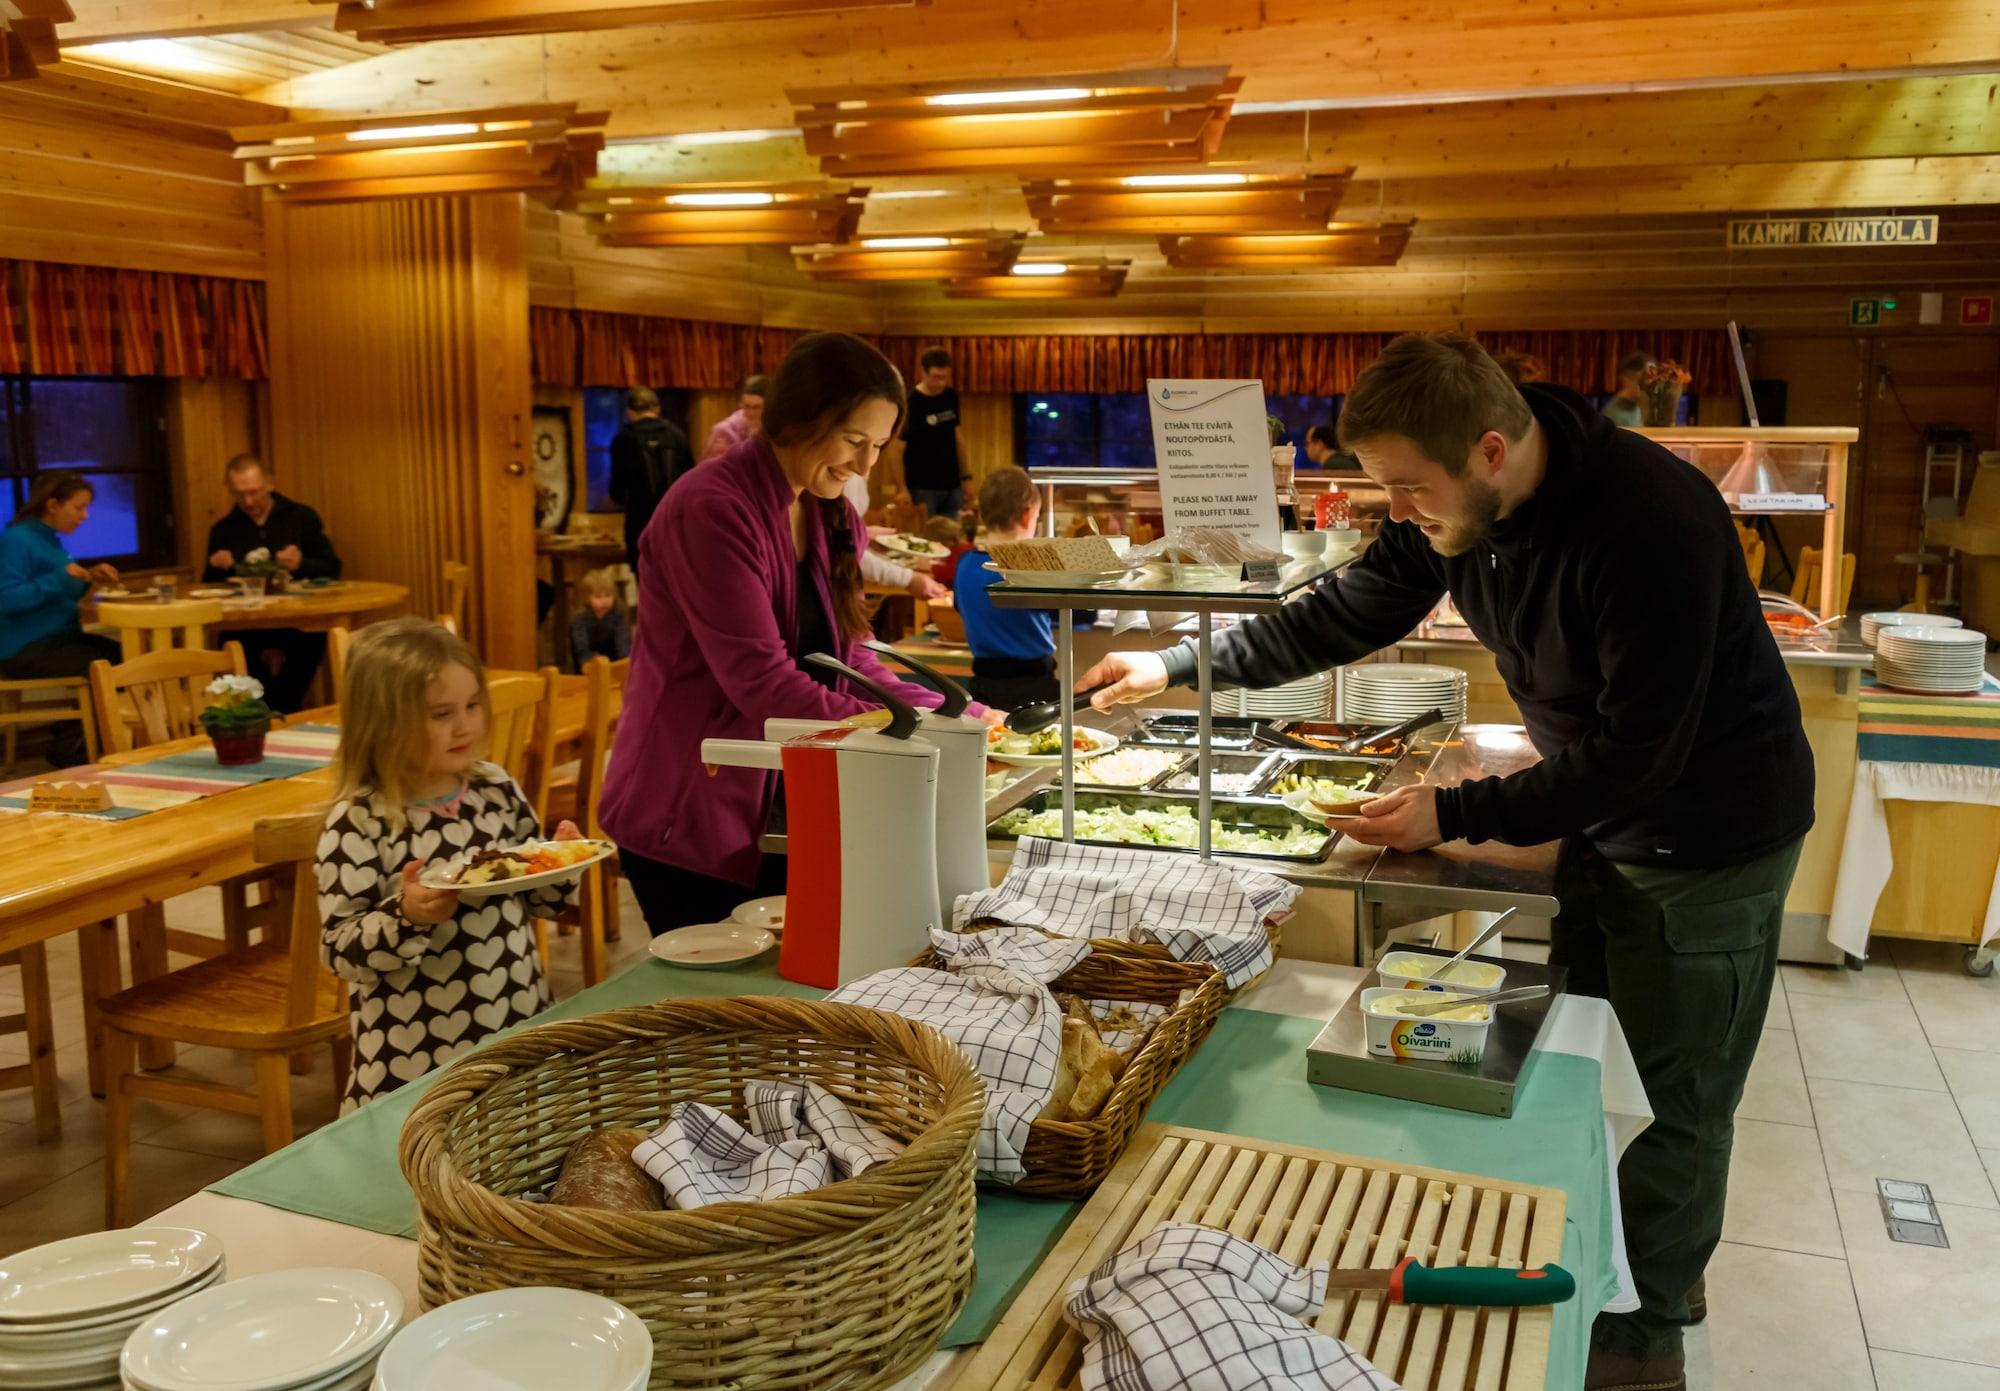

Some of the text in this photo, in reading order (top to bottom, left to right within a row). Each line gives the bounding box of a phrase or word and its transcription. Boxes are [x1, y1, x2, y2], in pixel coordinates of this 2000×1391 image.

[1738, 220, 1926, 244] KAMMI RAVINTOLA
[1164, 421, 1233, 430] ETHÄN TEE EVÄITÄ
[1166, 434, 1236, 444] NOUTOPÖYDÄSTÄ,
[1167, 449, 1194, 457] KIITOS.
[1173, 494, 1259, 504] PLEASE NO TAKE AWAY
[1174, 510, 1198, 518] FROM
[1199, 509, 1226, 517] BUFFET
[1397, 1034, 1452, 1048] Oivariini
